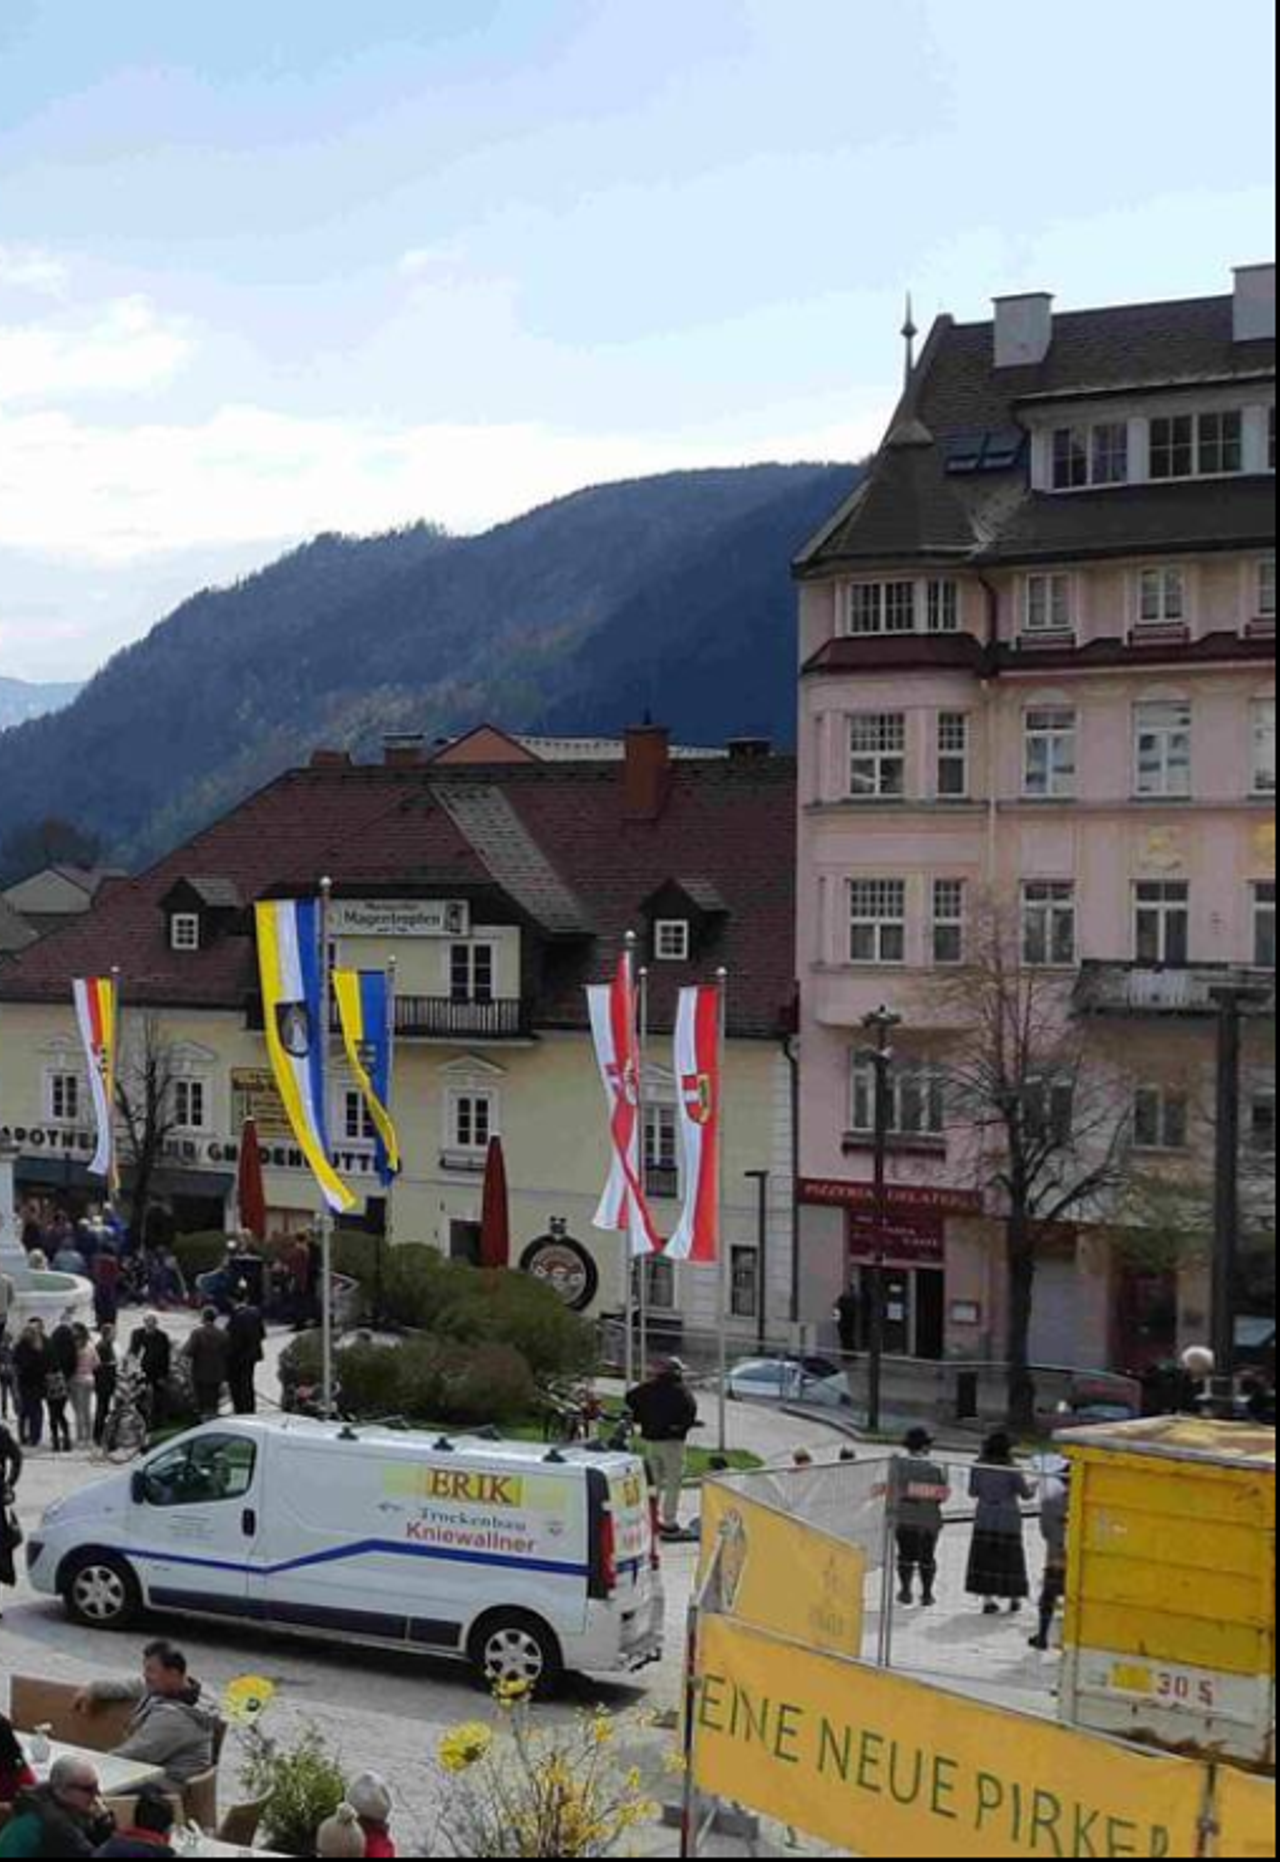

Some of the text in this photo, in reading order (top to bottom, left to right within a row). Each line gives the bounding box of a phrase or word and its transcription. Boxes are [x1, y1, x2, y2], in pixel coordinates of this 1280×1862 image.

[343, 910, 441, 928] Magentropfen
[428, 1468, 513, 1504] ERIK
[417, 1506, 527, 1532] Trockenbau
[405, 1522, 536, 1553] Kniewallner
[1157, 1673, 1190, 1698] 30
[699, 1673, 804, 1763] EINE
[819, 1717, 959, 1819] NEUE
